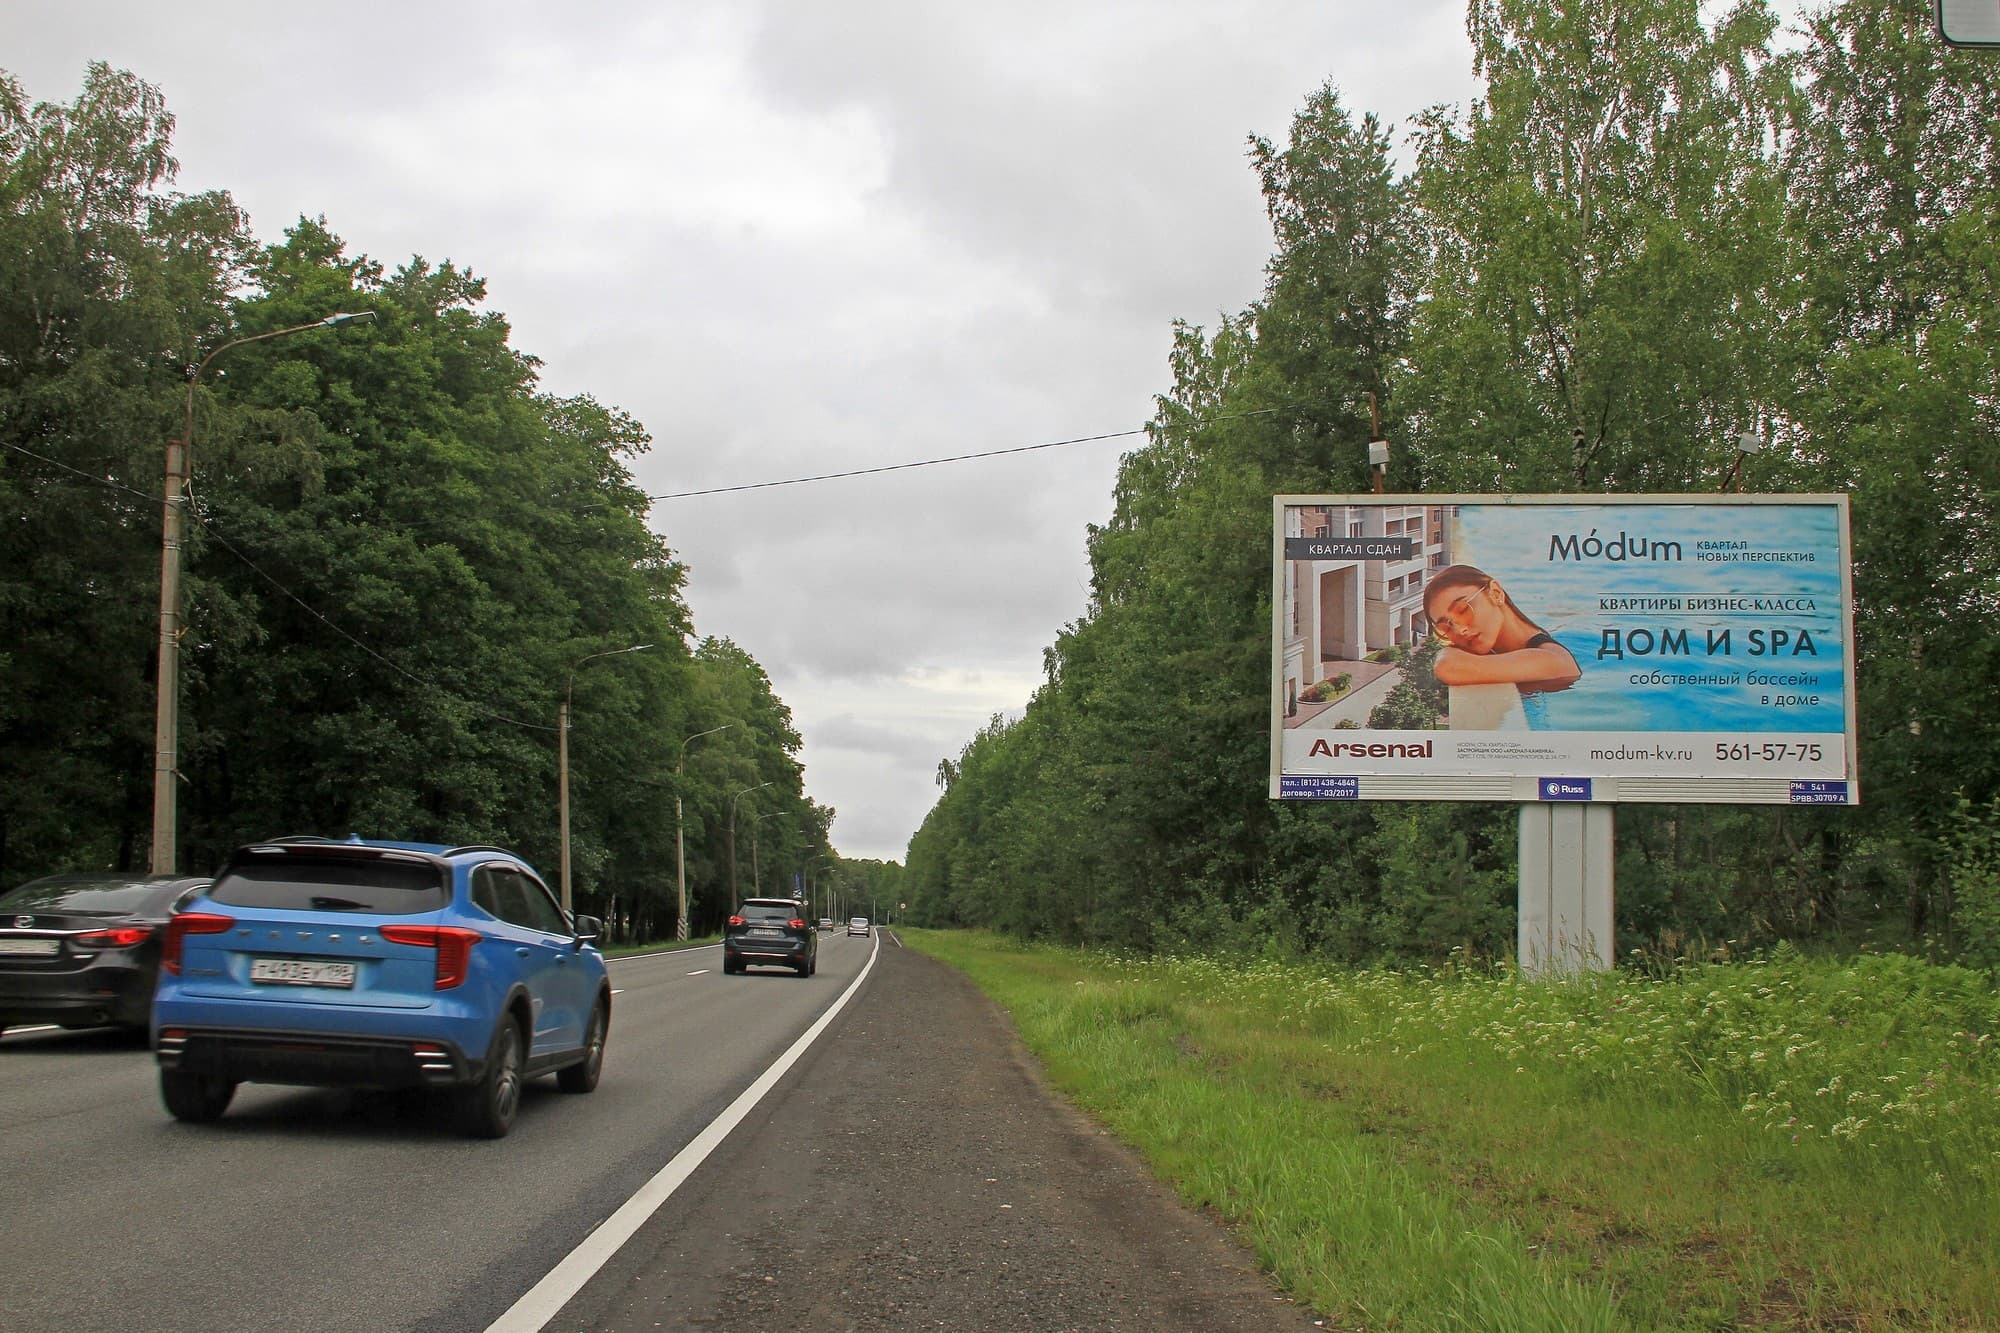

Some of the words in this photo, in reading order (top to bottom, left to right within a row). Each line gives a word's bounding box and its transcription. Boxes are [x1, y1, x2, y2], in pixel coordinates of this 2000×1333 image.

[1308, 544, 1362, 555] КВАРТАЛ
[1366, 544, 1401, 556] СДАН
[1696, 540, 1748, 550] КВАРТАЛ
[1696, 552, 1739, 562] НОВЫХ
[1742, 552, 1816, 563] ПЕРСПЕКТИВ
[1599, 598, 1682, 611] КВАРТИРЫ
[1687, 598, 1817, 612] БИЗНЕС-КЛАССА
[1597, 628, 1691, 661] ДОМ
[1706, 629, 1732, 656] И
[1747, 629, 1818, 656] SPA
[1629, 670, 1741, 686] собственный
[1746, 671, 1819, 687] бассейн
[1761, 695, 1770, 705] в
[1774, 694, 1820, 708] доме
[1308, 738, 1433, 759] Arsenal
[1590, 744, 1692, 761] modum-kv.ru
[1716, 743, 1822, 762] 561-57-75
[1281, 790, 1315, 798] договор:
[1561, 785, 1584, 793] Russ
[1811, 783, 1826, 791] 541
